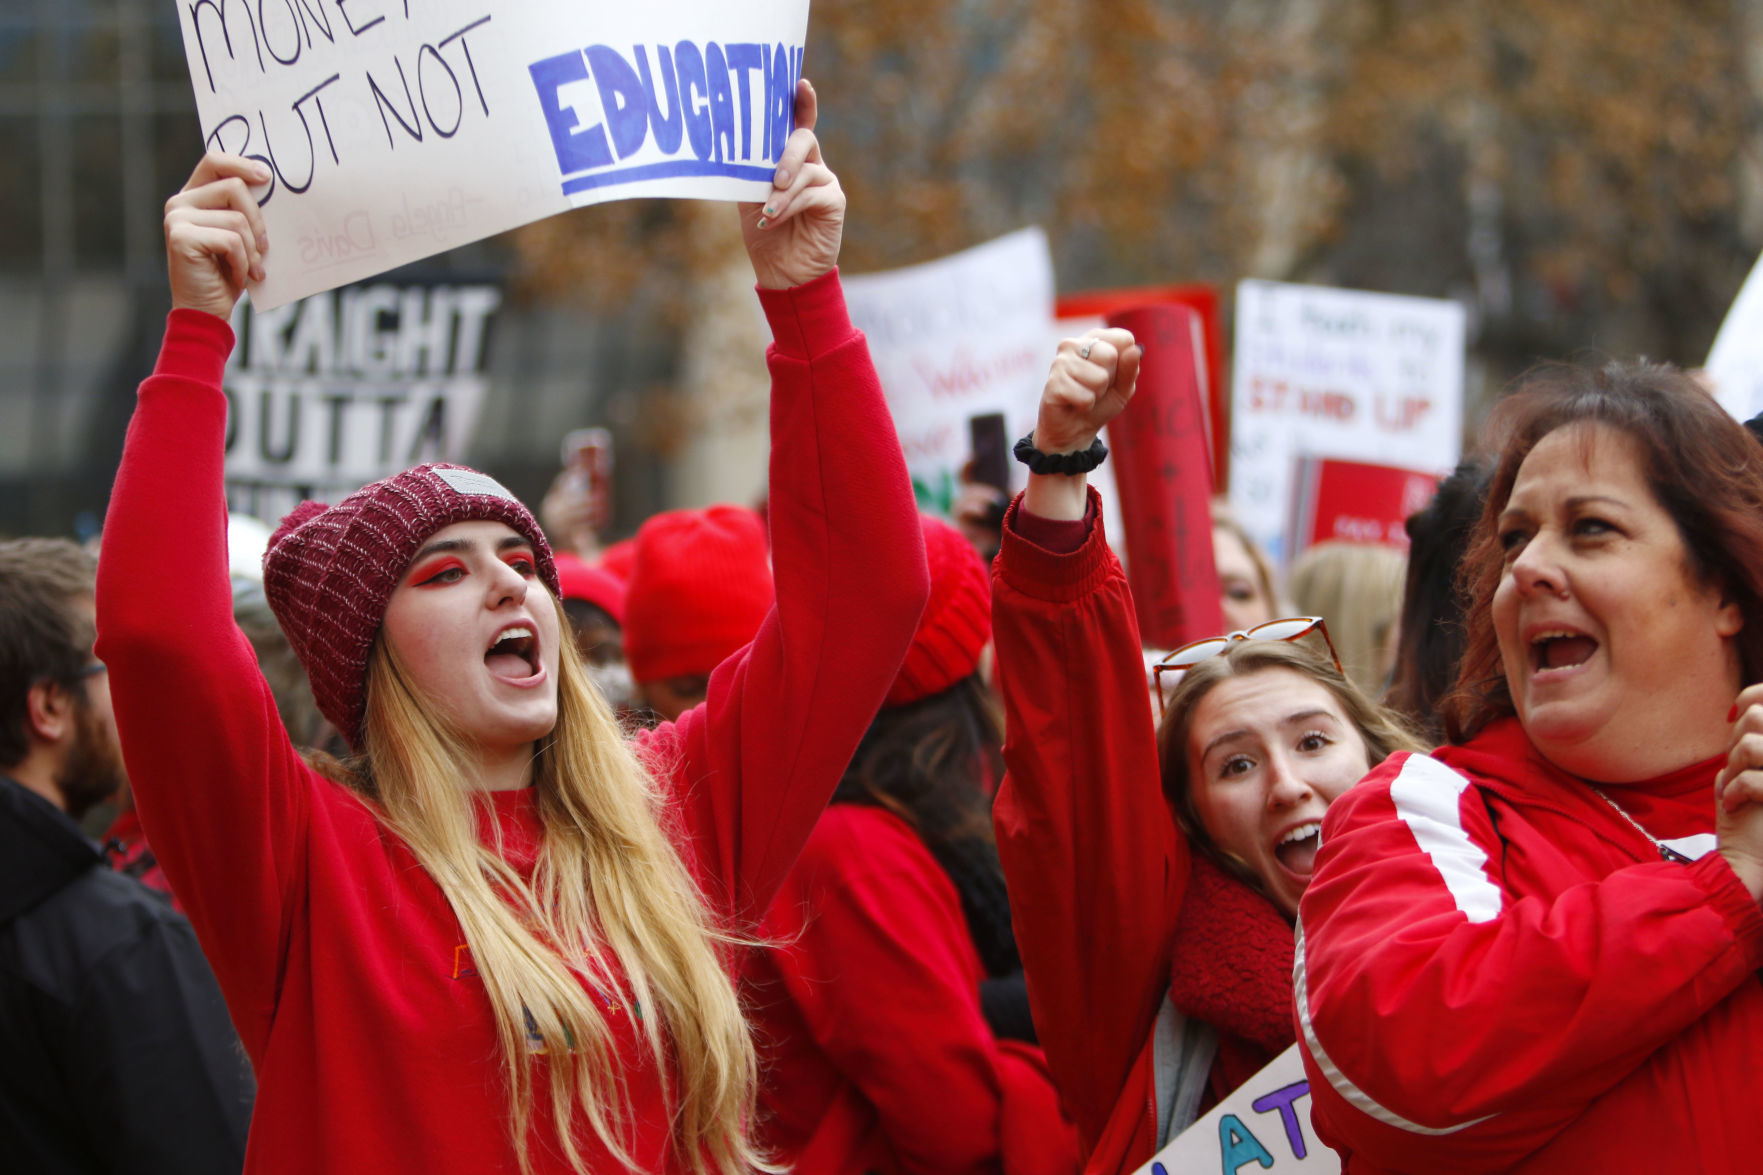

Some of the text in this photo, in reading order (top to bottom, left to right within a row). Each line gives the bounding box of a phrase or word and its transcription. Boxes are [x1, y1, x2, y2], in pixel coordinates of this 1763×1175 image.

[189, 0, 408, 93] MONE
[206, 14, 491, 208] BUT NOT
[1152, 1079, 1311, 1175] AT
